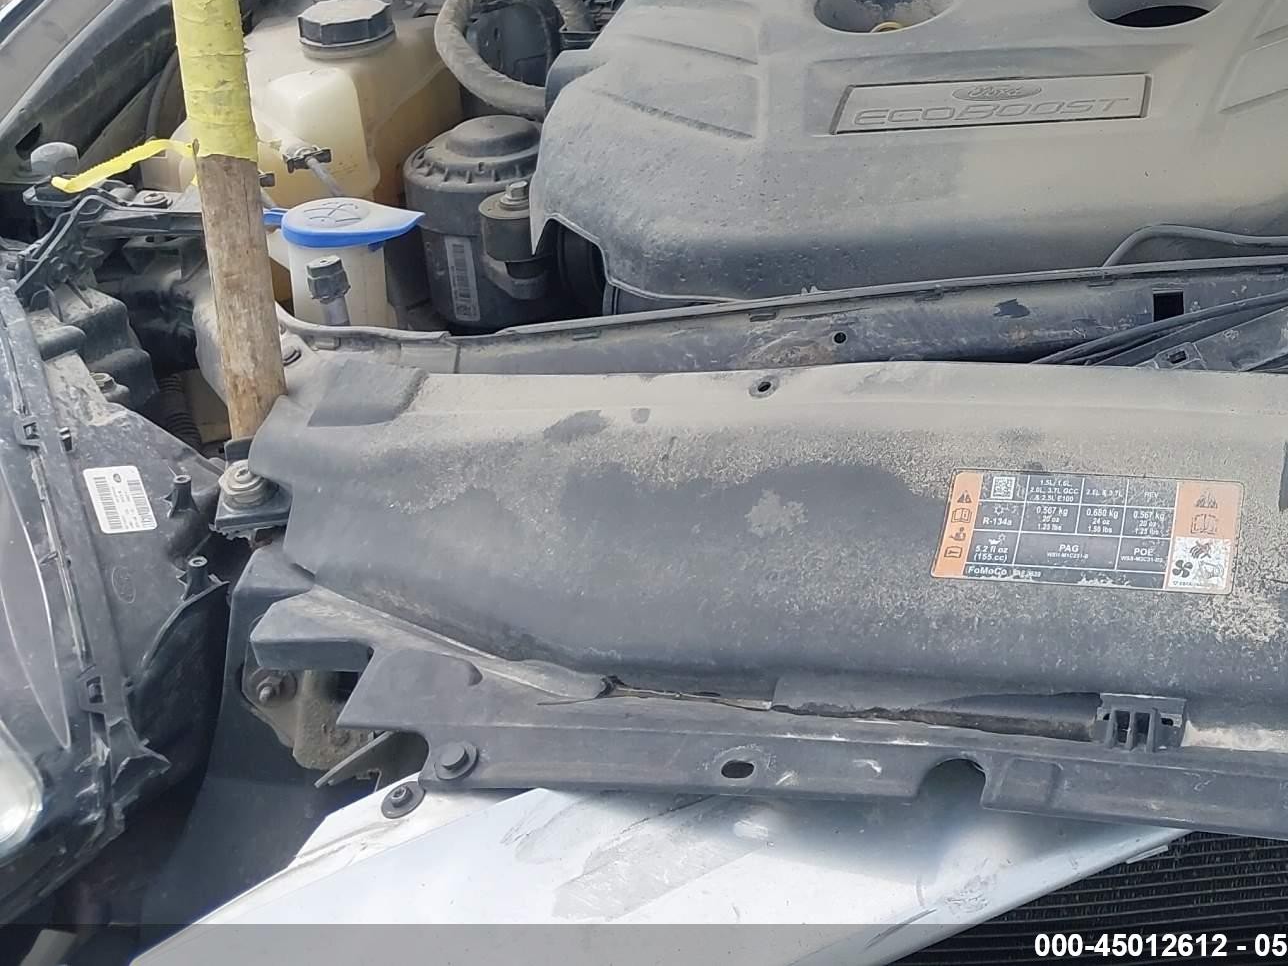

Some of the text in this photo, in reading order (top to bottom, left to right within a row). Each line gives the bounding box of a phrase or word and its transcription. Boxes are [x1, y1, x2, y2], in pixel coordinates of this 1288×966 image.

[854, 98, 1130, 125] ECOBOOST
[1109, 508, 1119, 519] kg
[982, 516, 1012, 526] R-134a
[1058, 544, 1080, 553] PAG
[1133, 548, 1154, 557] POE
[968, 566, 1007, 575] FoMoCo
